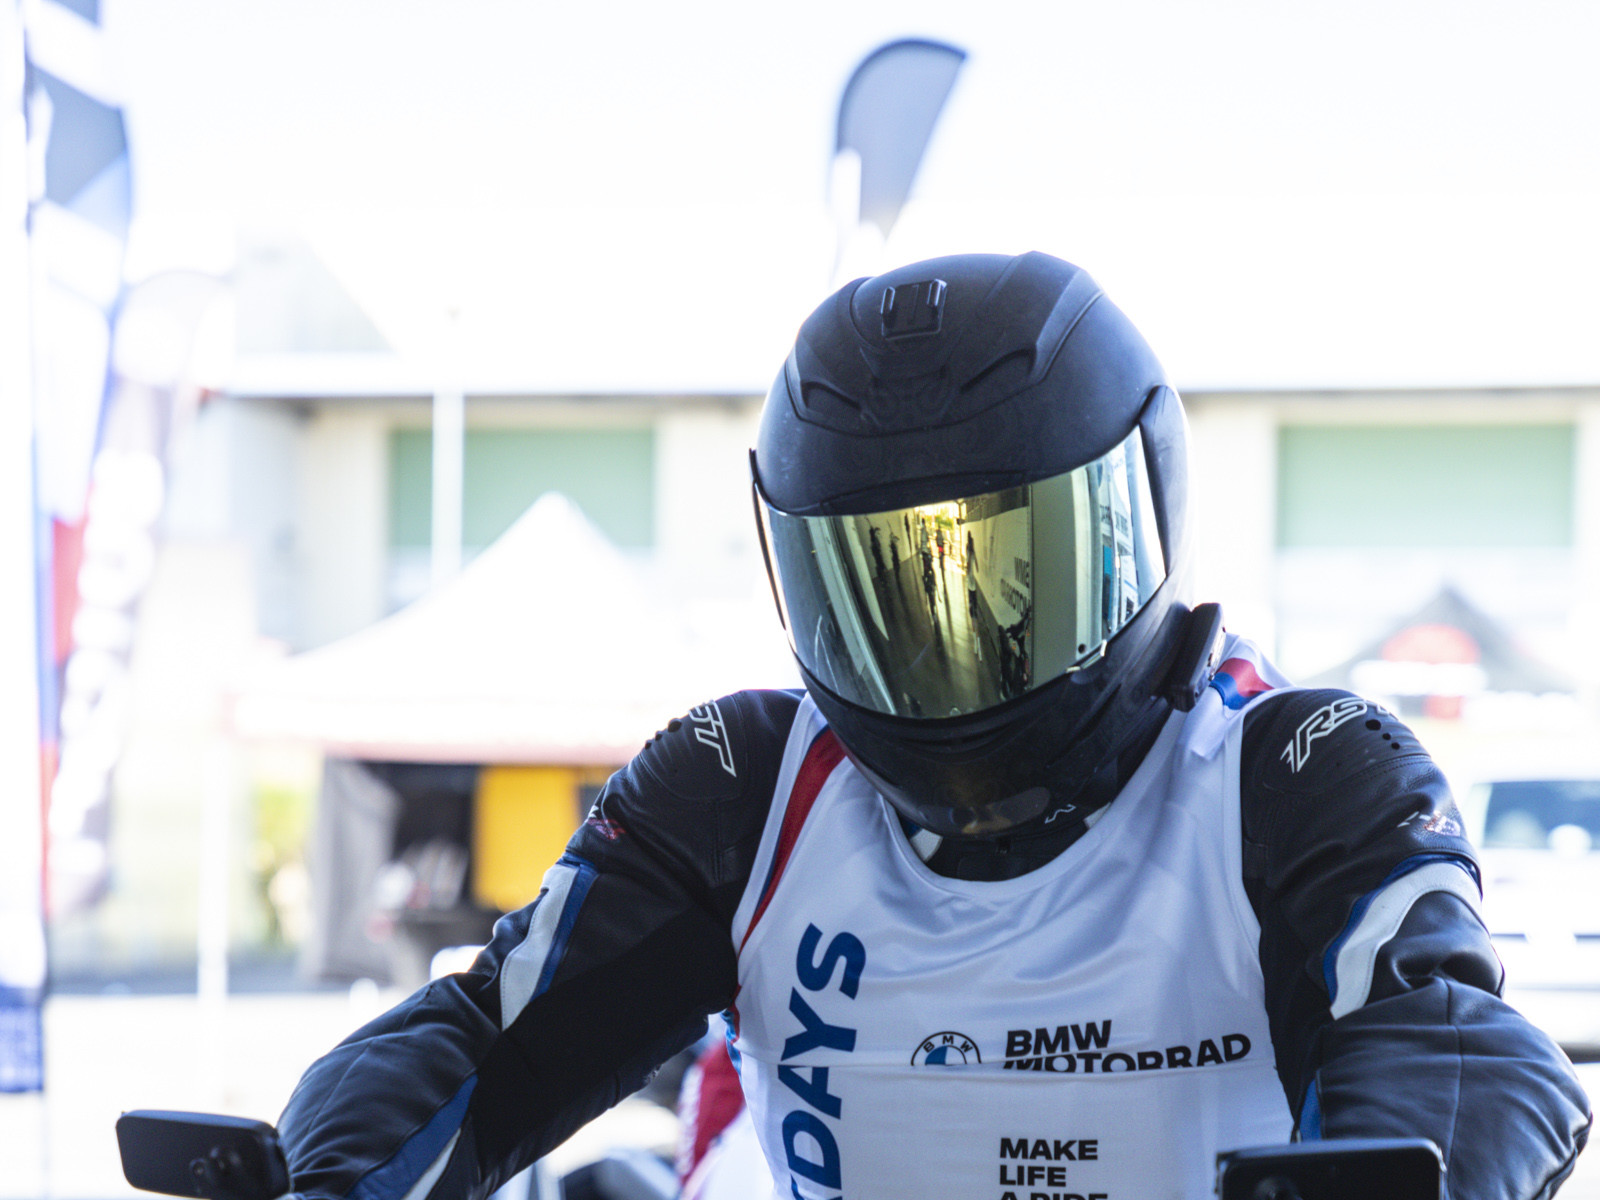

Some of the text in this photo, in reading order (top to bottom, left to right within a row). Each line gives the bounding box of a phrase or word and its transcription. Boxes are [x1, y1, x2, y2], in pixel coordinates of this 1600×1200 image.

[922, 1034, 974, 1054] BMW
[1005, 1019, 1112, 1057] BMW
[999, 1137, 1098, 1161] MAKE
[999, 1165, 1067, 1187] LIFE
